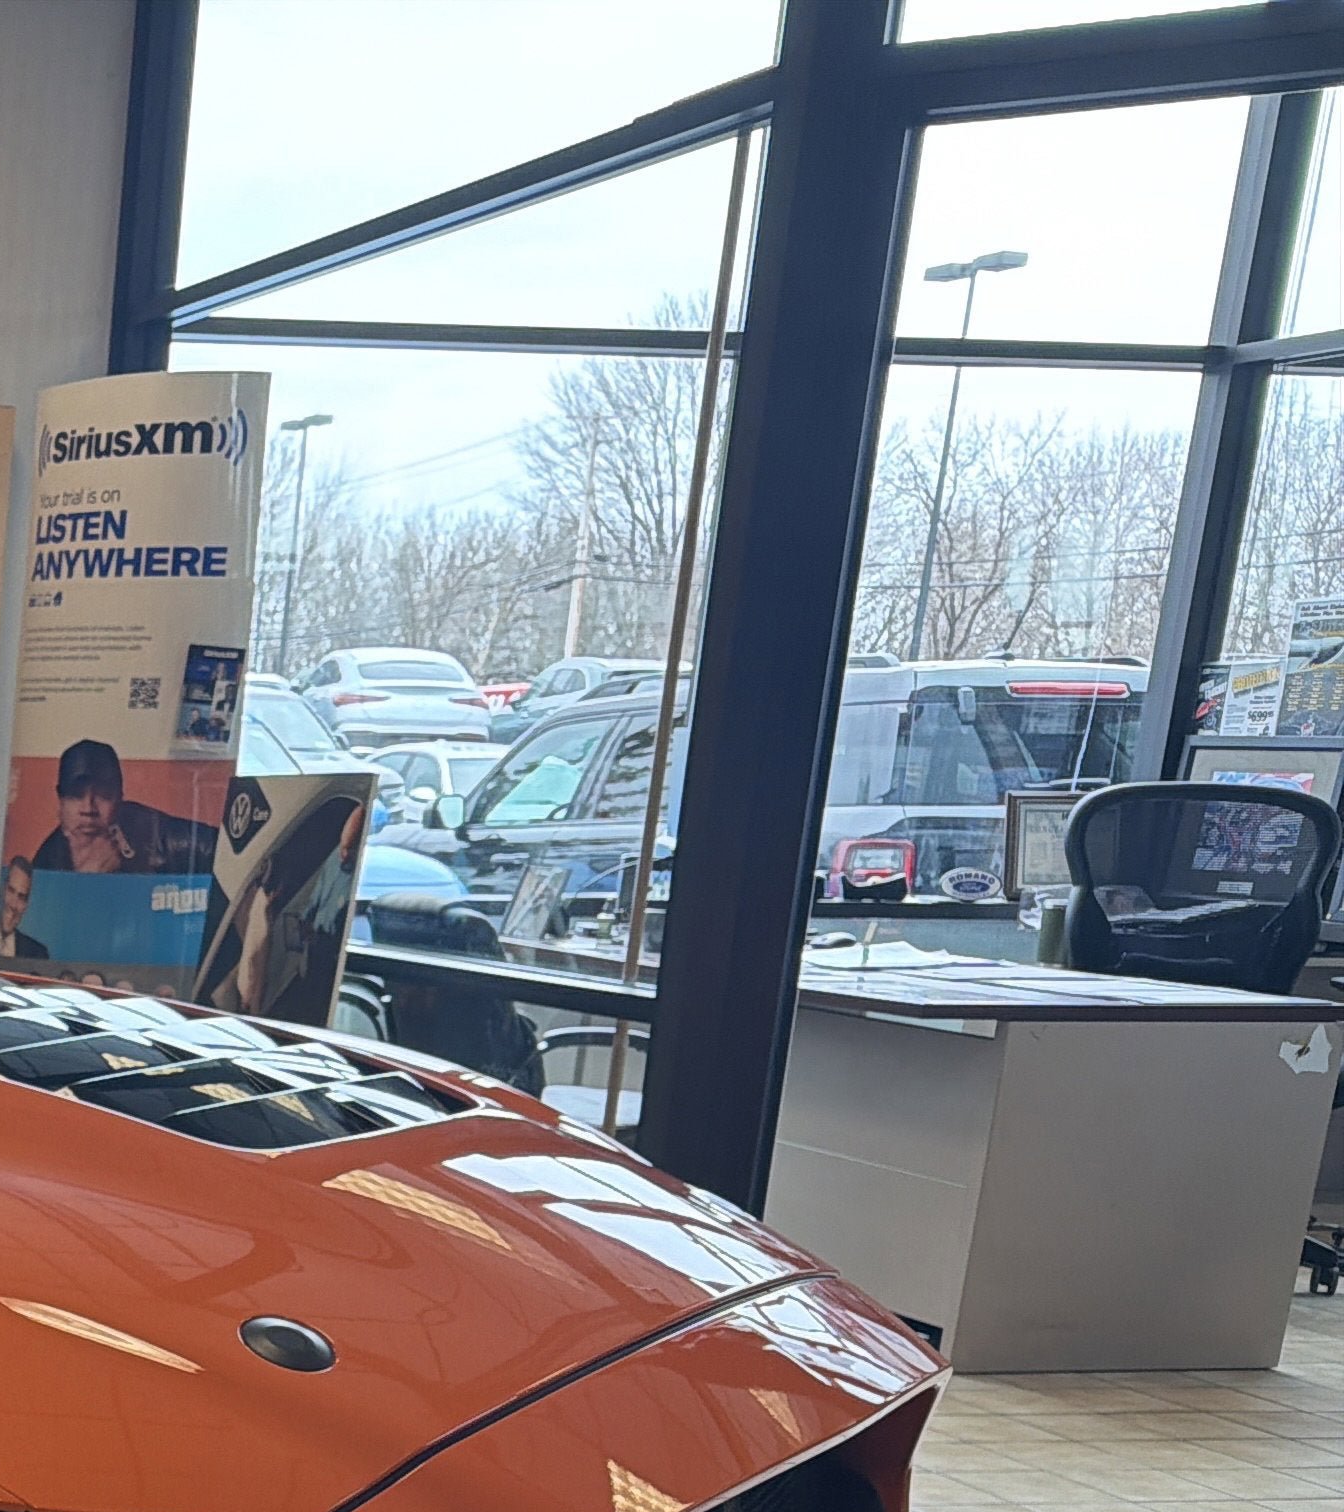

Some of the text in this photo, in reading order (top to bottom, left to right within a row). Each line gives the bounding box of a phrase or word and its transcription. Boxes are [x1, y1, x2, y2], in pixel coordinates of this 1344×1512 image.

[62, 488, 84, 506] trial
[86, 488, 97, 504] is
[100, 489, 121, 503] on
[35, 509, 128, 545] LISTEN
[31, 546, 229, 582] ANYWHERE
